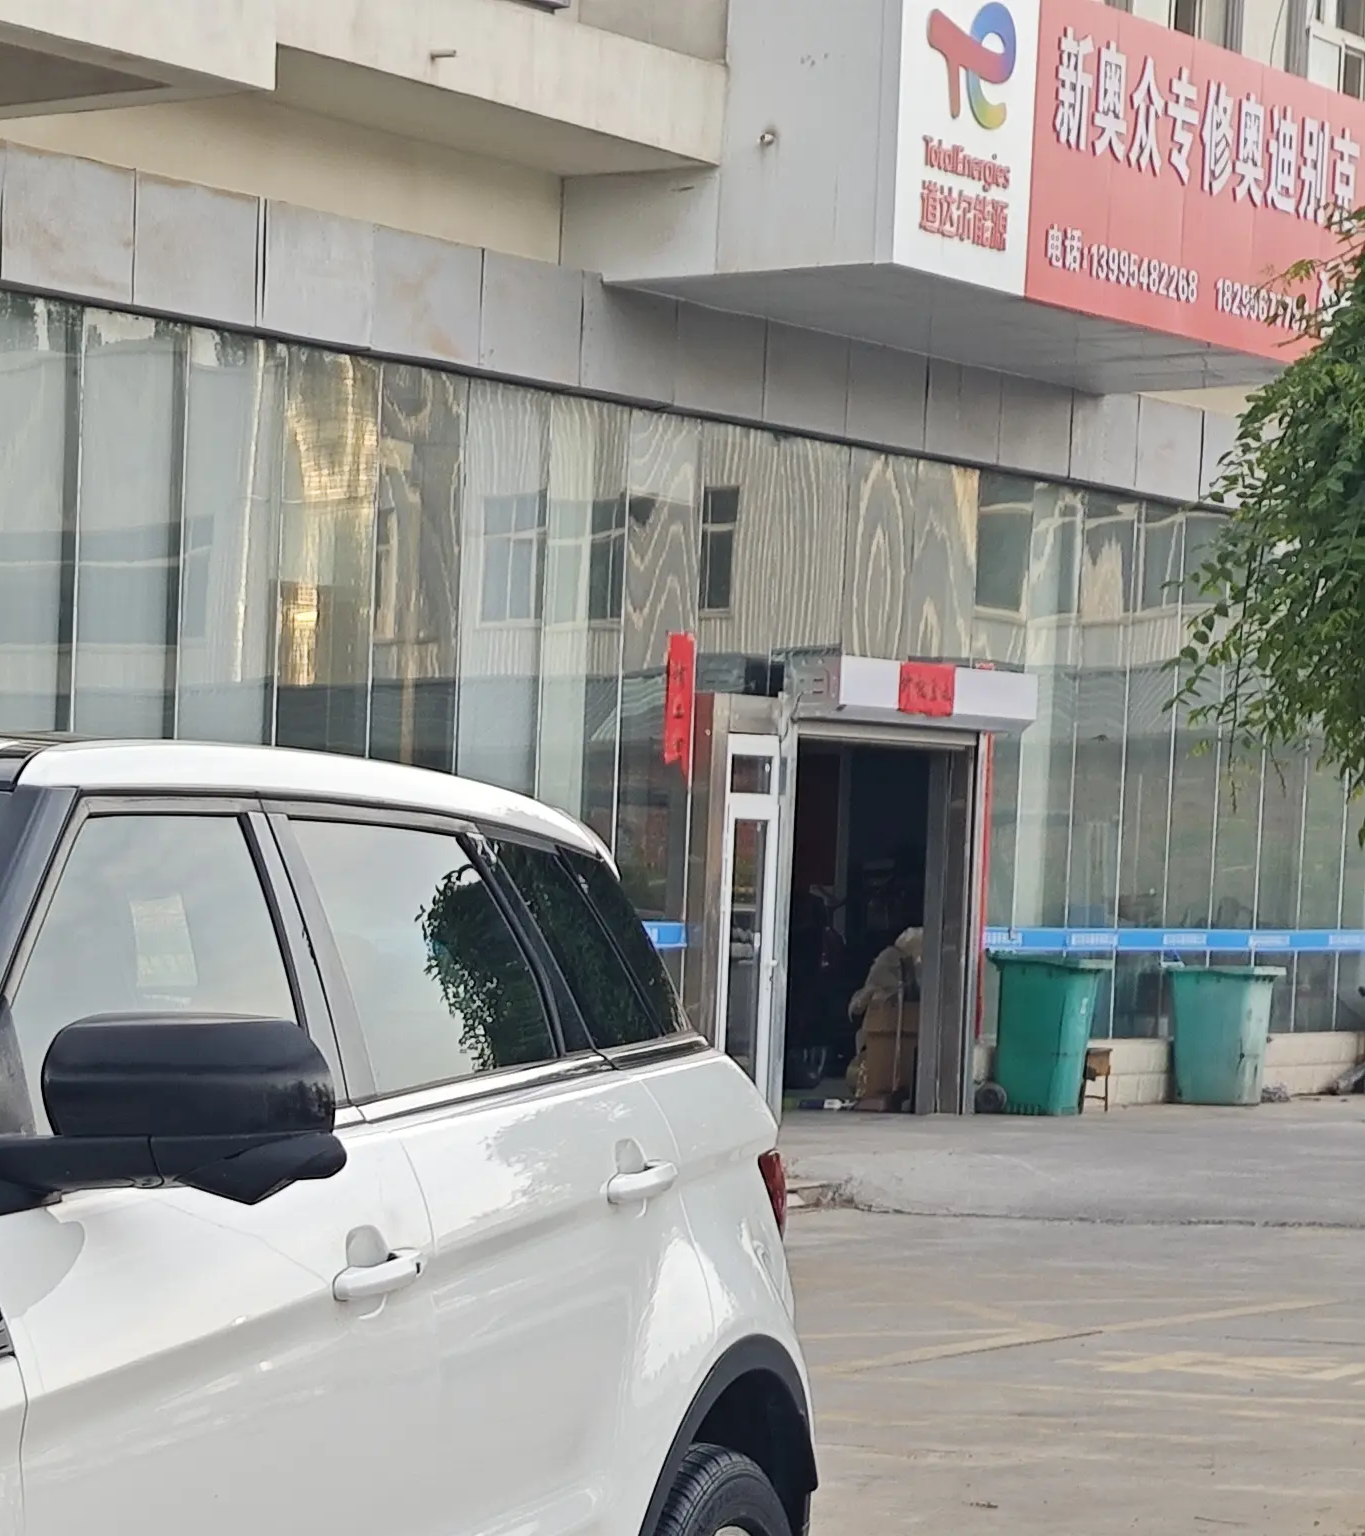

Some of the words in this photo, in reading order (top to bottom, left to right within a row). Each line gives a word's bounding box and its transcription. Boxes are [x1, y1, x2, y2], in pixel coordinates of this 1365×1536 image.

[922, 135, 1011, 192] TotalEnergies
[918, 180, 1009, 252] 道达尔能源
